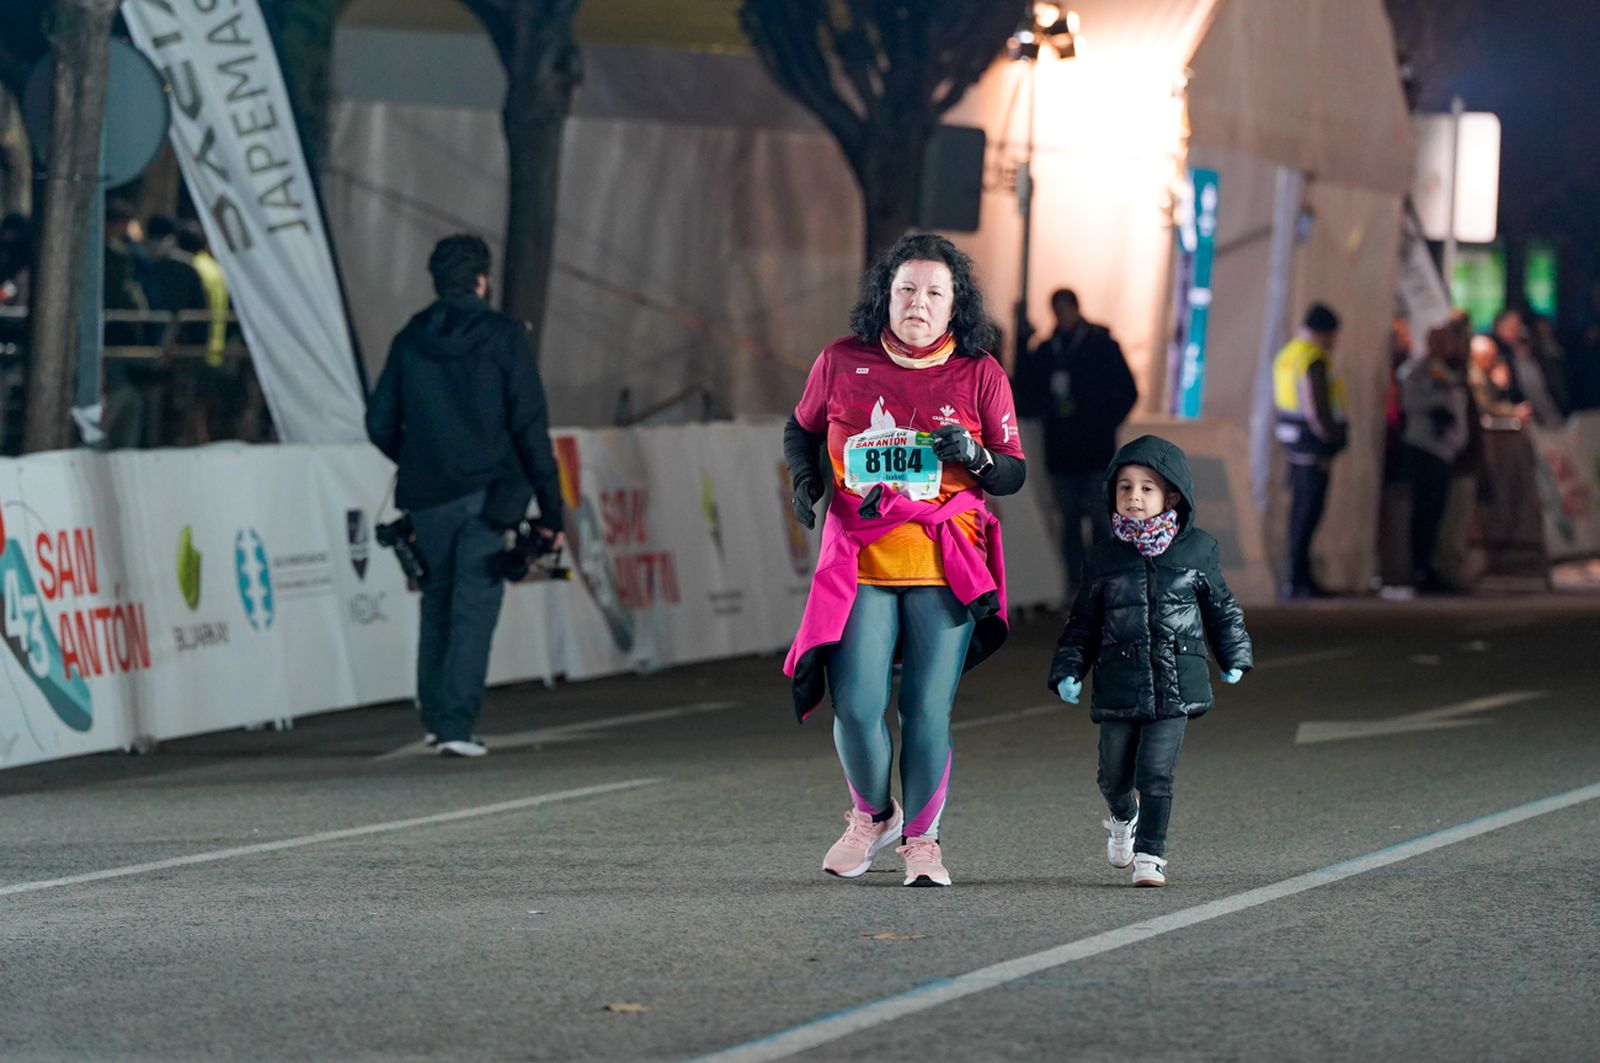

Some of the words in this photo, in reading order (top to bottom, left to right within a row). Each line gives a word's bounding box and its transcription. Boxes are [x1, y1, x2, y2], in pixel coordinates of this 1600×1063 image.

[865, 447, 923, 473] 8184
[36, 527, 98, 601] SAN
[59, 581, 151, 681] ANTÓN
